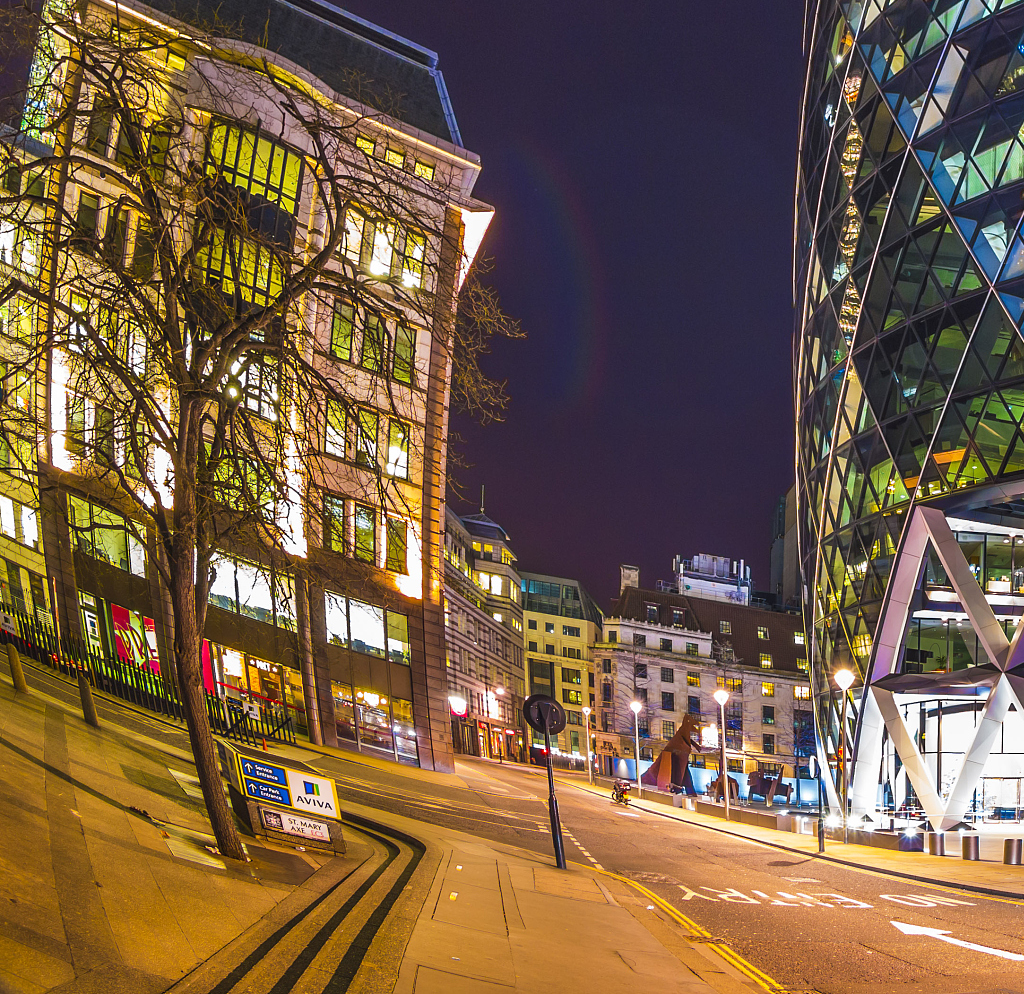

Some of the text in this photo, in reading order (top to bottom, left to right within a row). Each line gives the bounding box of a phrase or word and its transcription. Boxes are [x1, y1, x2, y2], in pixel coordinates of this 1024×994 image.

[254, 764, 273, 774] Service
[256, 770, 279, 781] Entrance
[260, 790, 283, 801] Entrance
[268, 787, 280, 795] Park
[296, 795, 333, 811] AVIVA
[287, 817, 322, 831] ST. MARY
[290, 826, 325, 838] AXE EC3
[677, 884, 978, 909] NO ENTRY
